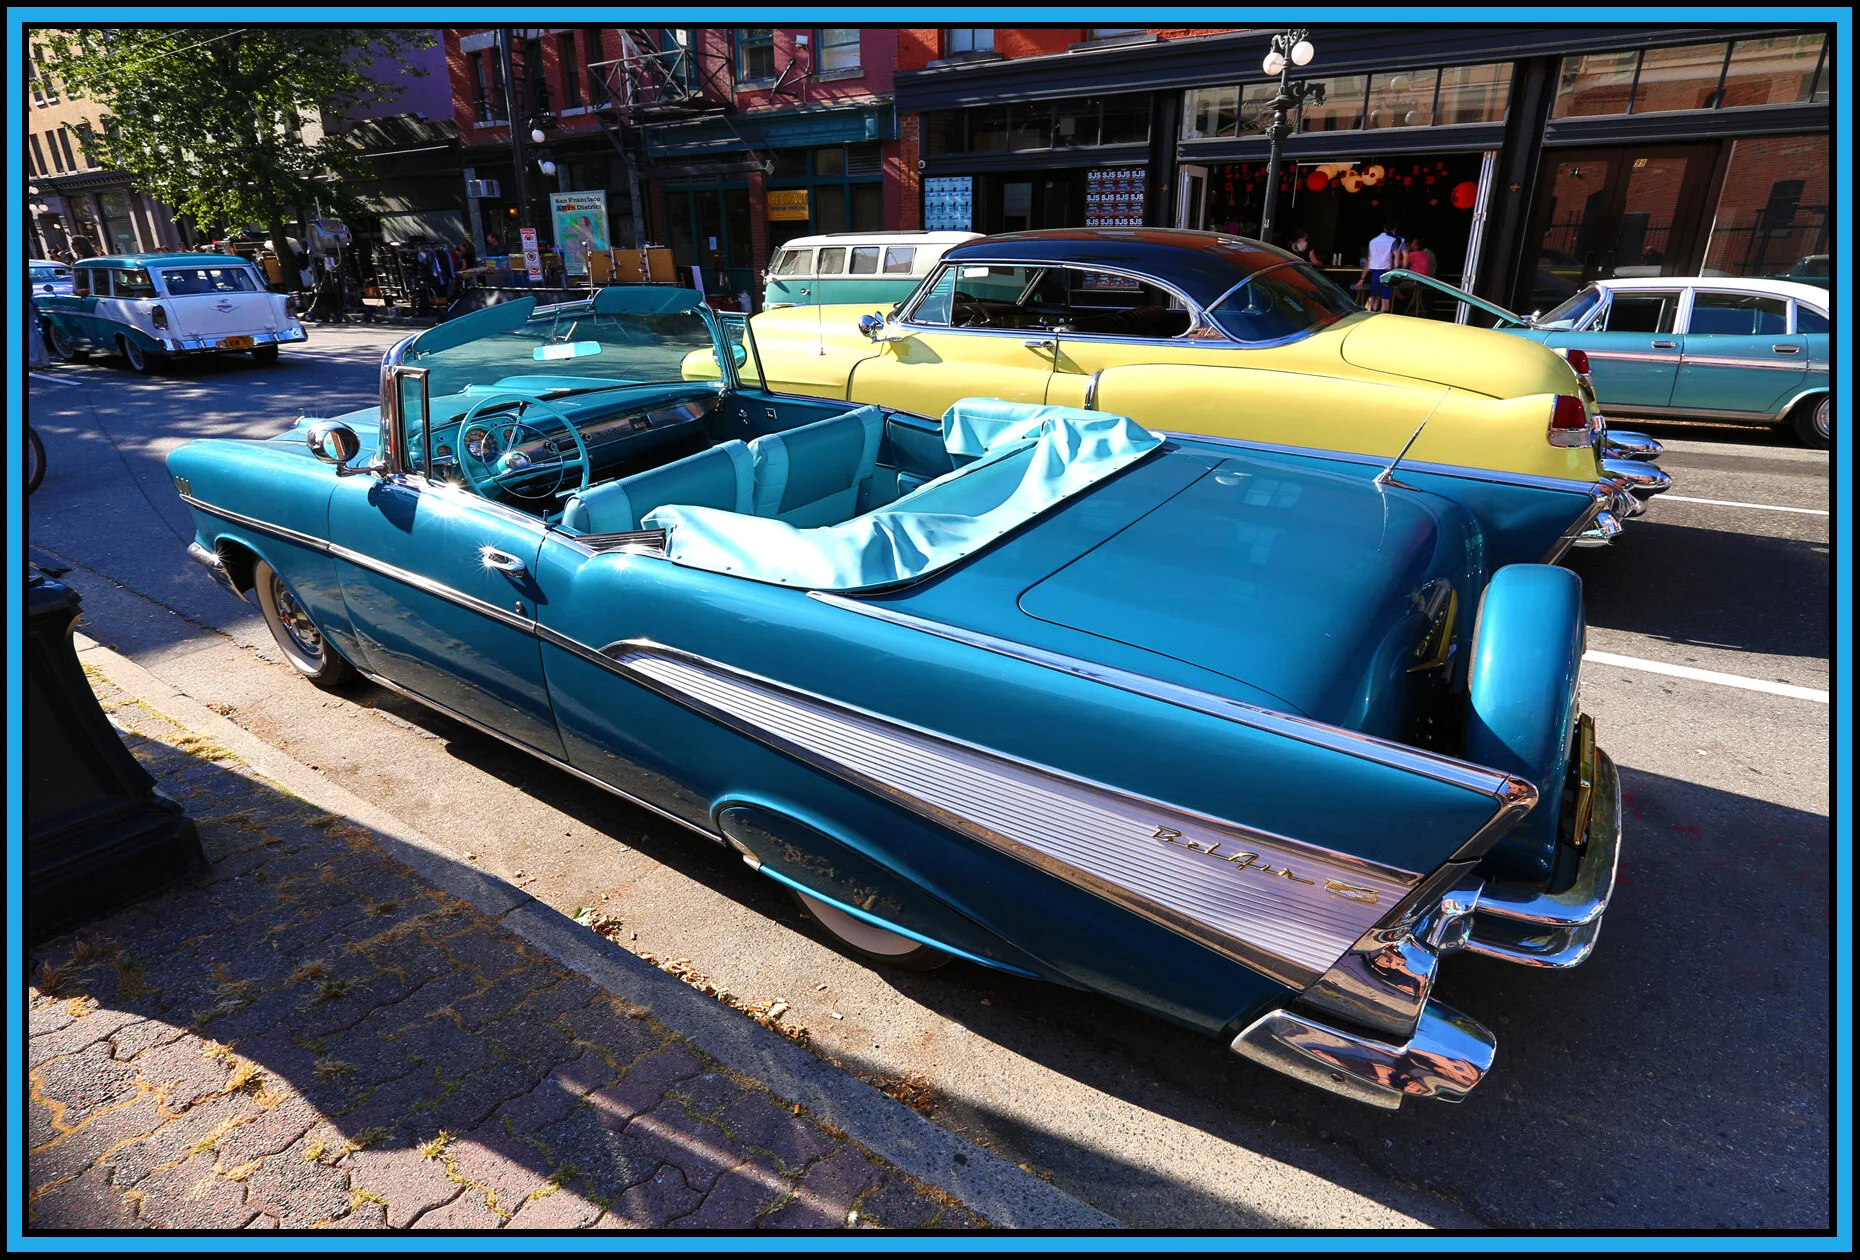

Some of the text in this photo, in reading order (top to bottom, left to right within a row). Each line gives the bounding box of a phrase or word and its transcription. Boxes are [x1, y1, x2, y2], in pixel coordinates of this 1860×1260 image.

[1633, 159, 1648, 168] 99
[1151, 824, 1315, 886] Bel Air
